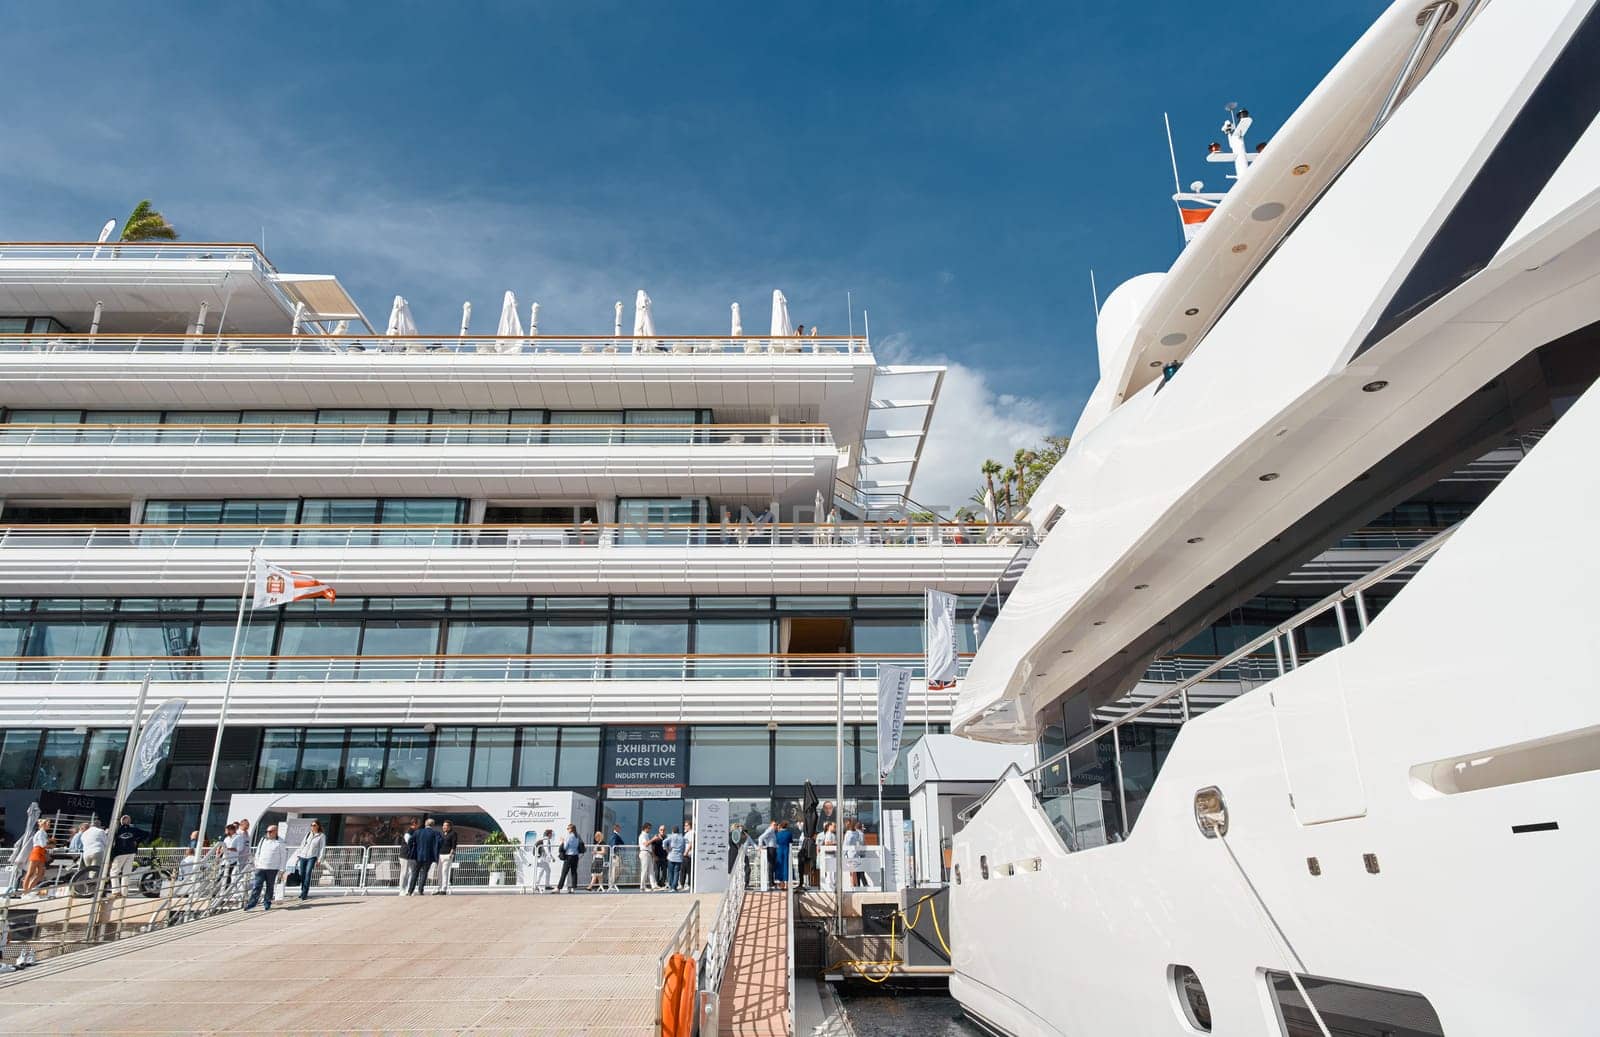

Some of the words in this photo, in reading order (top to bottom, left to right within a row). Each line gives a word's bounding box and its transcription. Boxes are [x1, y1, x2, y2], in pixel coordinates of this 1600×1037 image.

[891, 672, 908, 751] Sunseeker
[616, 744, 676, 753] EXHIBITION
[615, 757, 650, 767] RACES
[653, 757, 676, 767] LIVE
[66, 797, 96, 810] FRASER
[507, 809, 520, 818] DC
